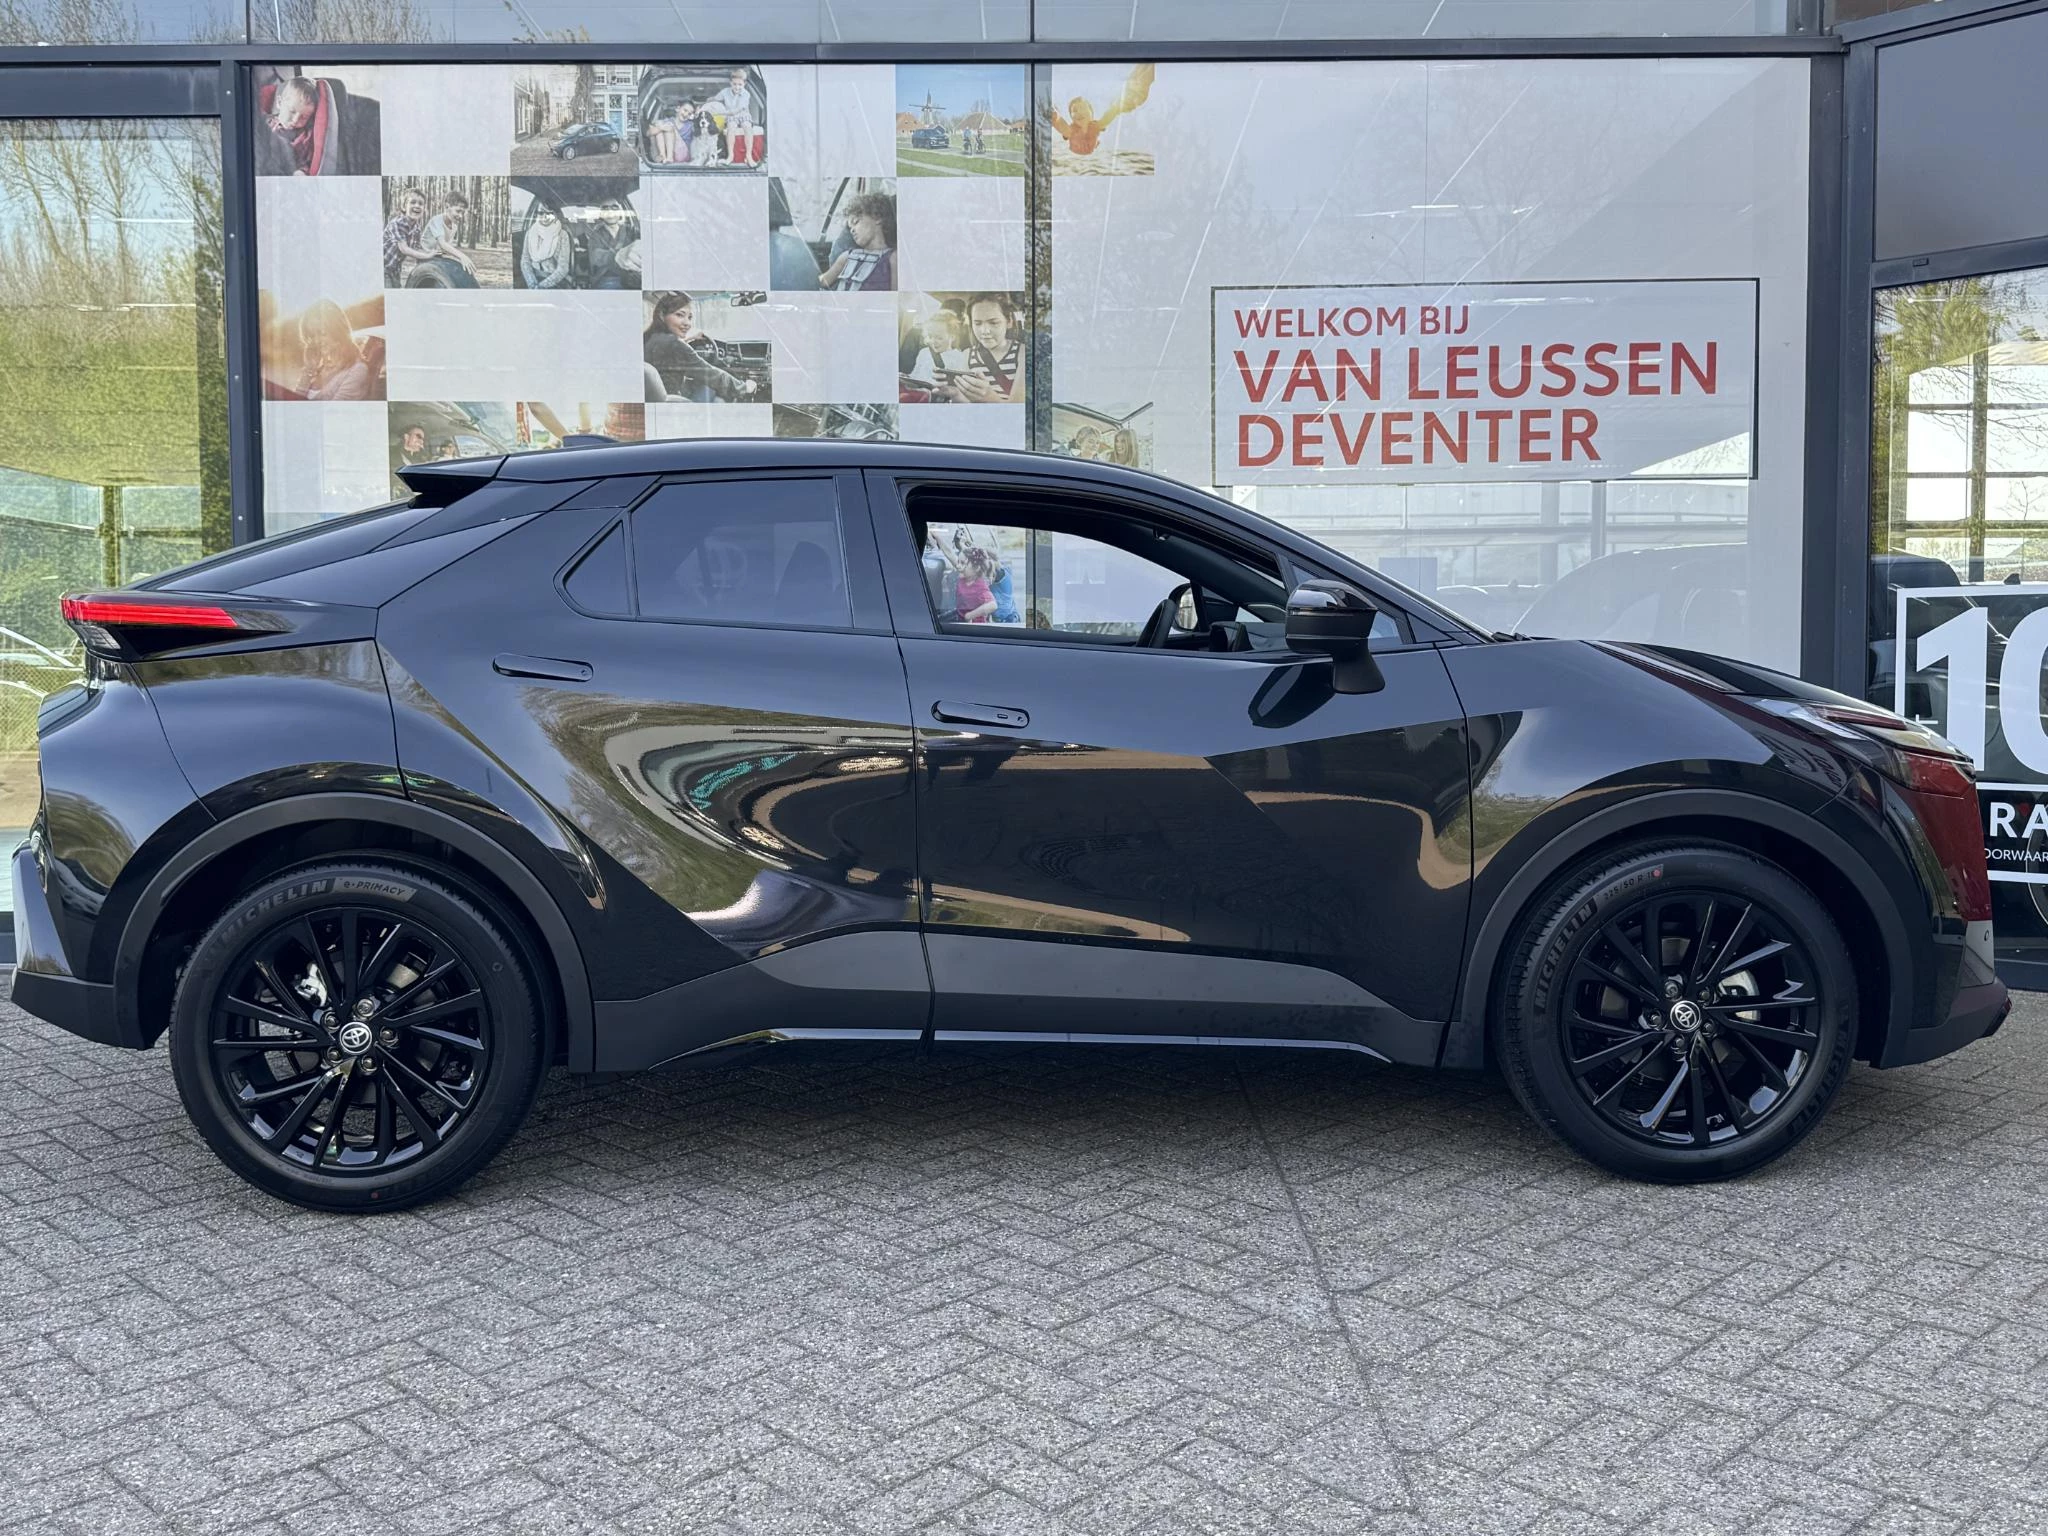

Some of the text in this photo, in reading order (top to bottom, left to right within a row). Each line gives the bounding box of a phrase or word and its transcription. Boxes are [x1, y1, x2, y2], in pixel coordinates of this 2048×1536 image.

[1234, 305, 1470, 338] WELKOM BIJ
[1234, 341, 1717, 403] VAN LEUSSEN
[1238, 408, 1602, 467] DEVENTER
[1534, 902, 1593, 1008] MICHELIN
